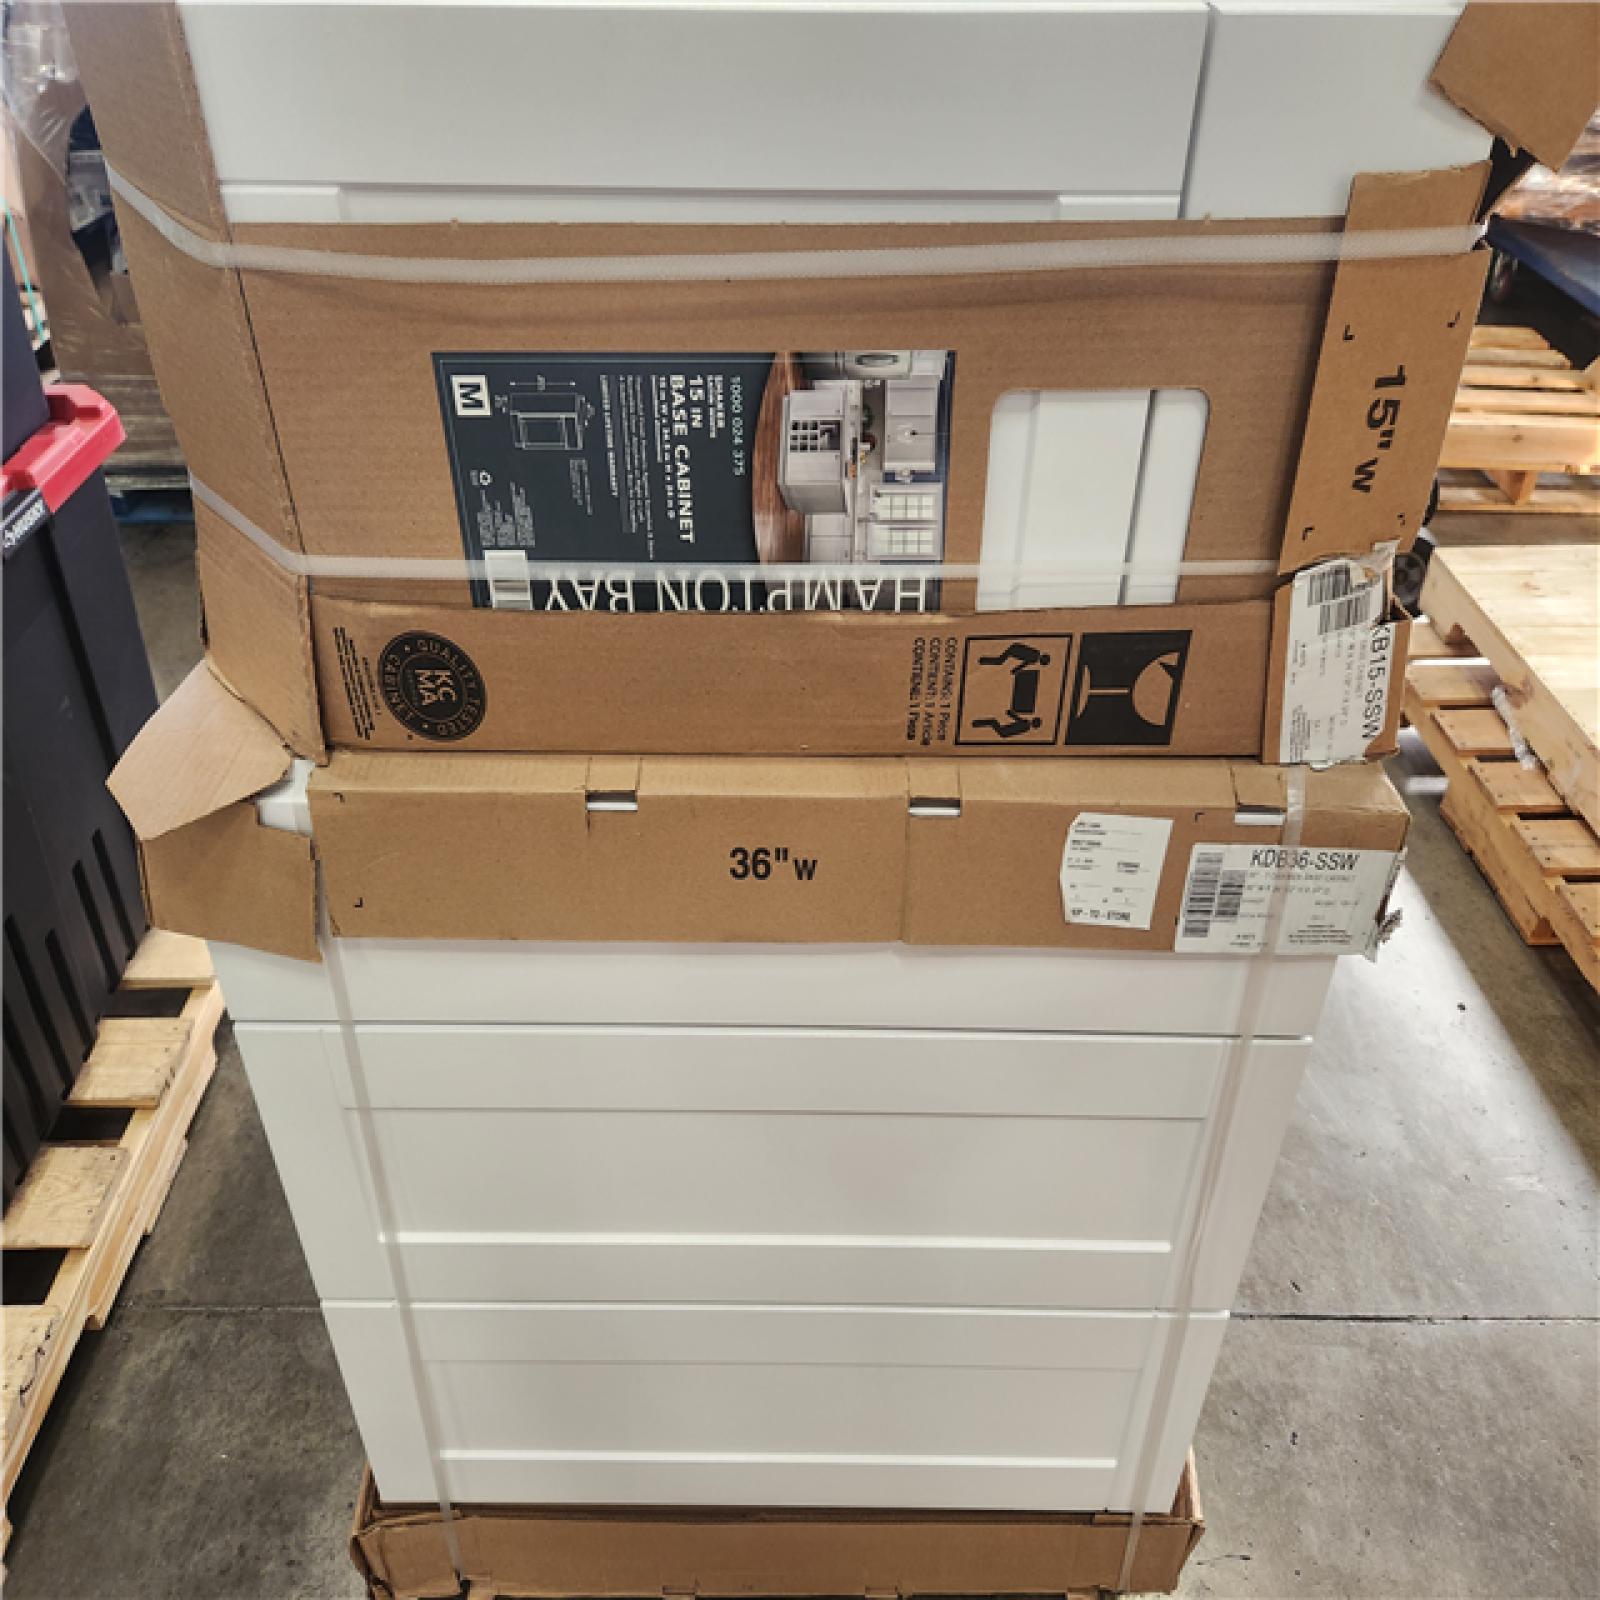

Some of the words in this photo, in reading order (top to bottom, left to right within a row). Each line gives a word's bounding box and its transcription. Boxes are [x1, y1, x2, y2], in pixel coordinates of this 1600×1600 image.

[459, 384, 484, 409] M
[670, 374, 688, 436] BASE
[689, 375, 705, 401] 15
[1367, 364, 1405, 449] 15"
[690, 407, 704, 428] IN
[674, 444, 695, 543] CABINET
[545, 569, 634, 612] BAY
[655, 569, 928, 612] HAMPTON
[729, 847, 788, 880] 36"
[1250, 849, 1360, 871] KDB36-SSW
